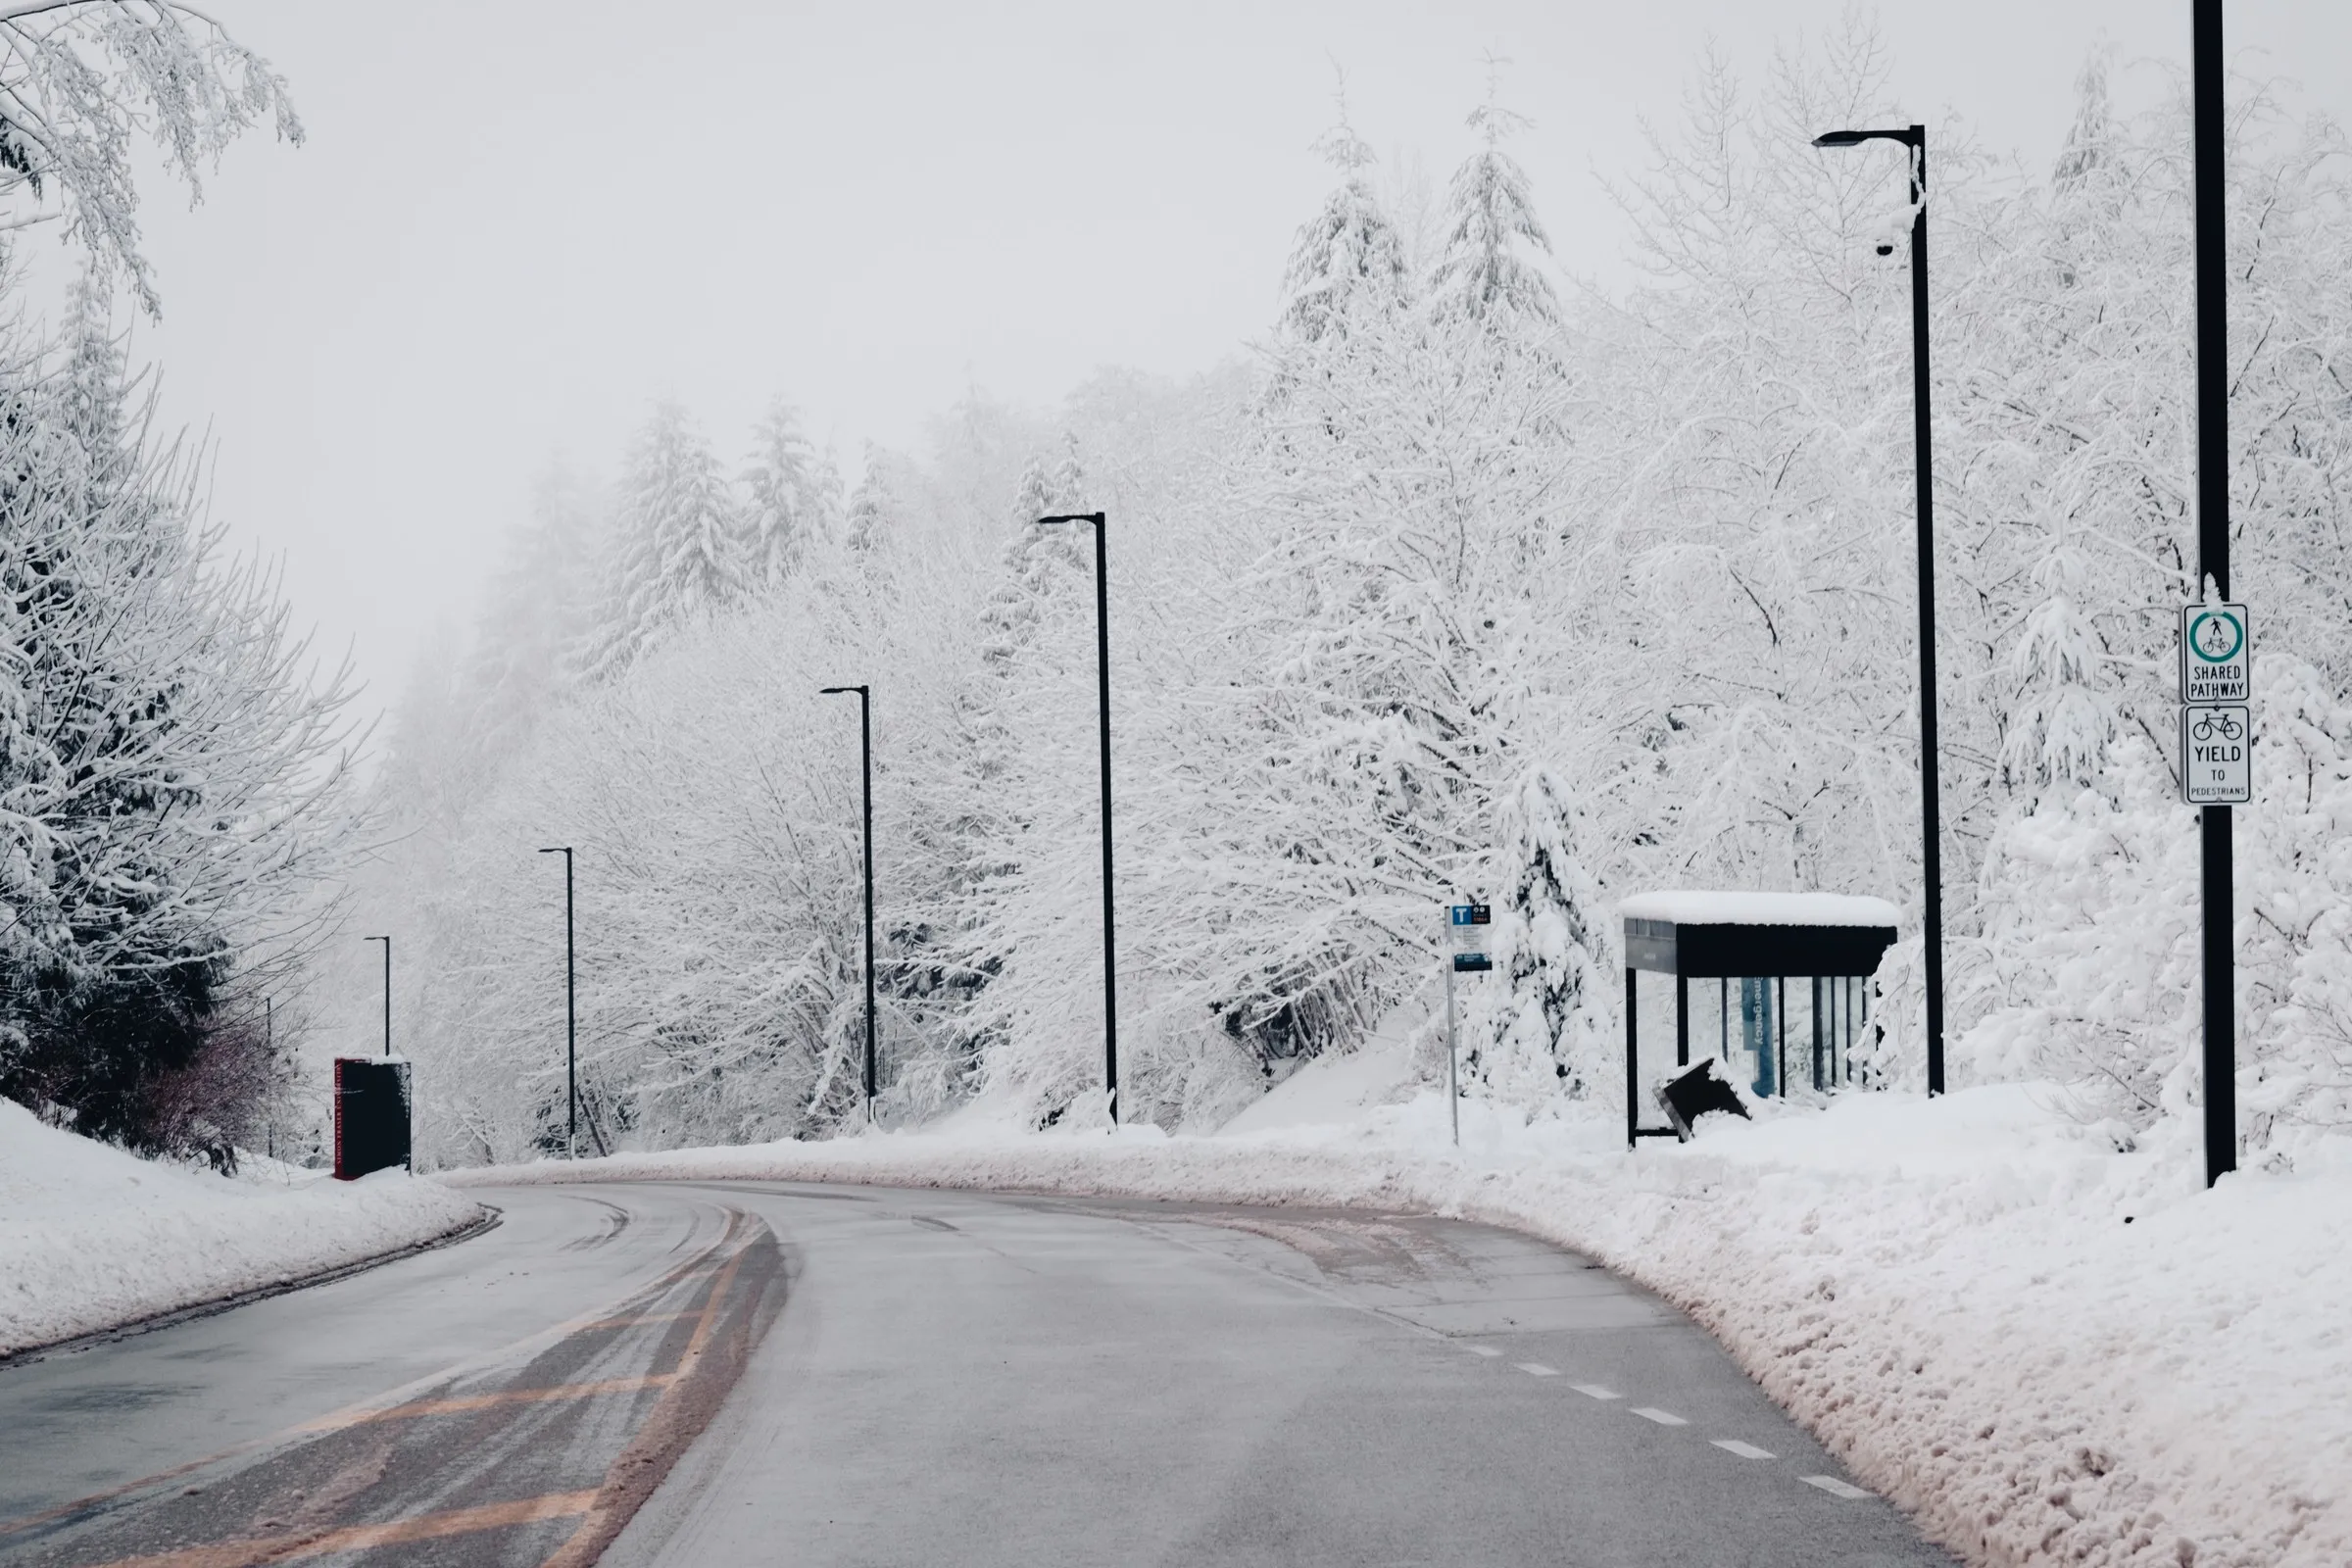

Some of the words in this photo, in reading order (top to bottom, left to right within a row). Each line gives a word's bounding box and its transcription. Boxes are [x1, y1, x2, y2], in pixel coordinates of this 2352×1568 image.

[2194, 665, 2241, 680] SHARED
[2191, 682, 2244, 697] PATHWAY
[2194, 746, 2241, 762] YIELD
[2211, 769, 2226, 781] TO
[2191, 787, 2246, 796] PEDESTRIANS
[1455, 907, 1467, 923] T
